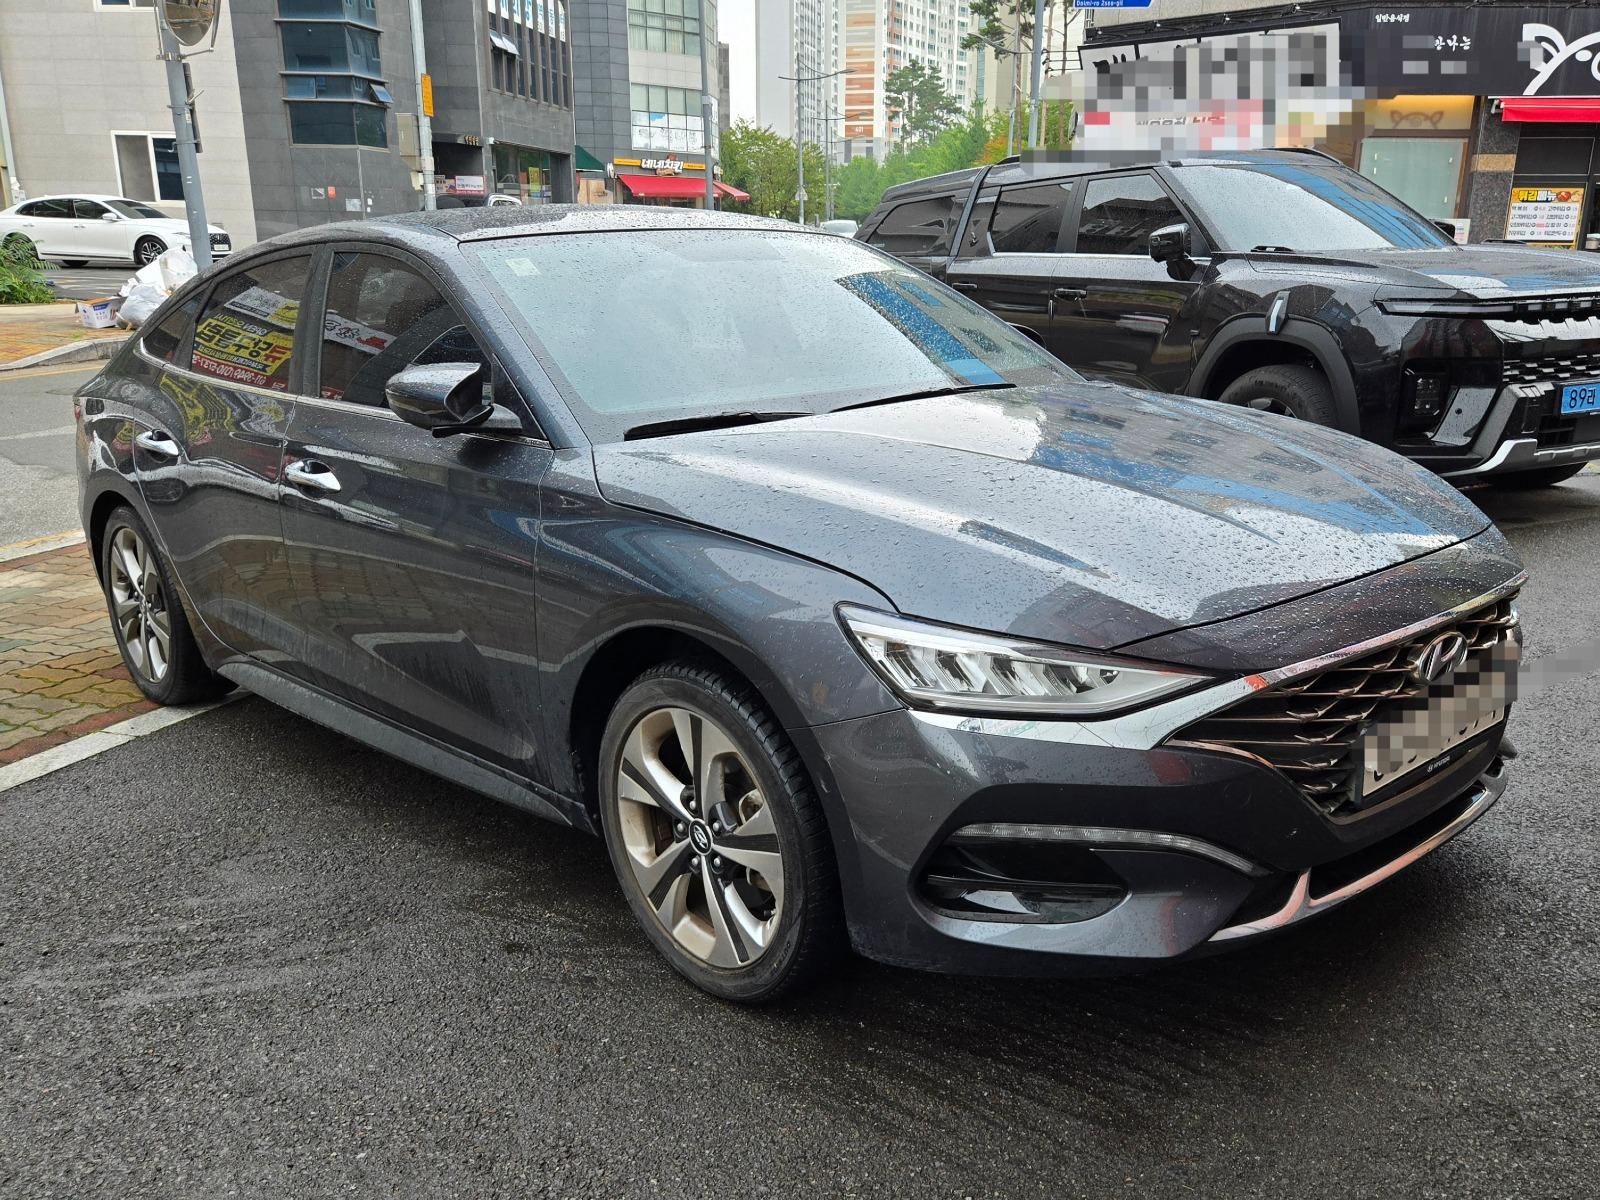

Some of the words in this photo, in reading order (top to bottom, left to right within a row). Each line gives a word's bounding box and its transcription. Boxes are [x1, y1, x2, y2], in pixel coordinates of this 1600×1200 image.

[1375, 13, 1410, 23] 일반음식점
[641, 158, 684, 173] 네네치킨
[1519, 189, 1557, 201] 튀김메뉴
[1569, 388, 1596, 409] 89라
